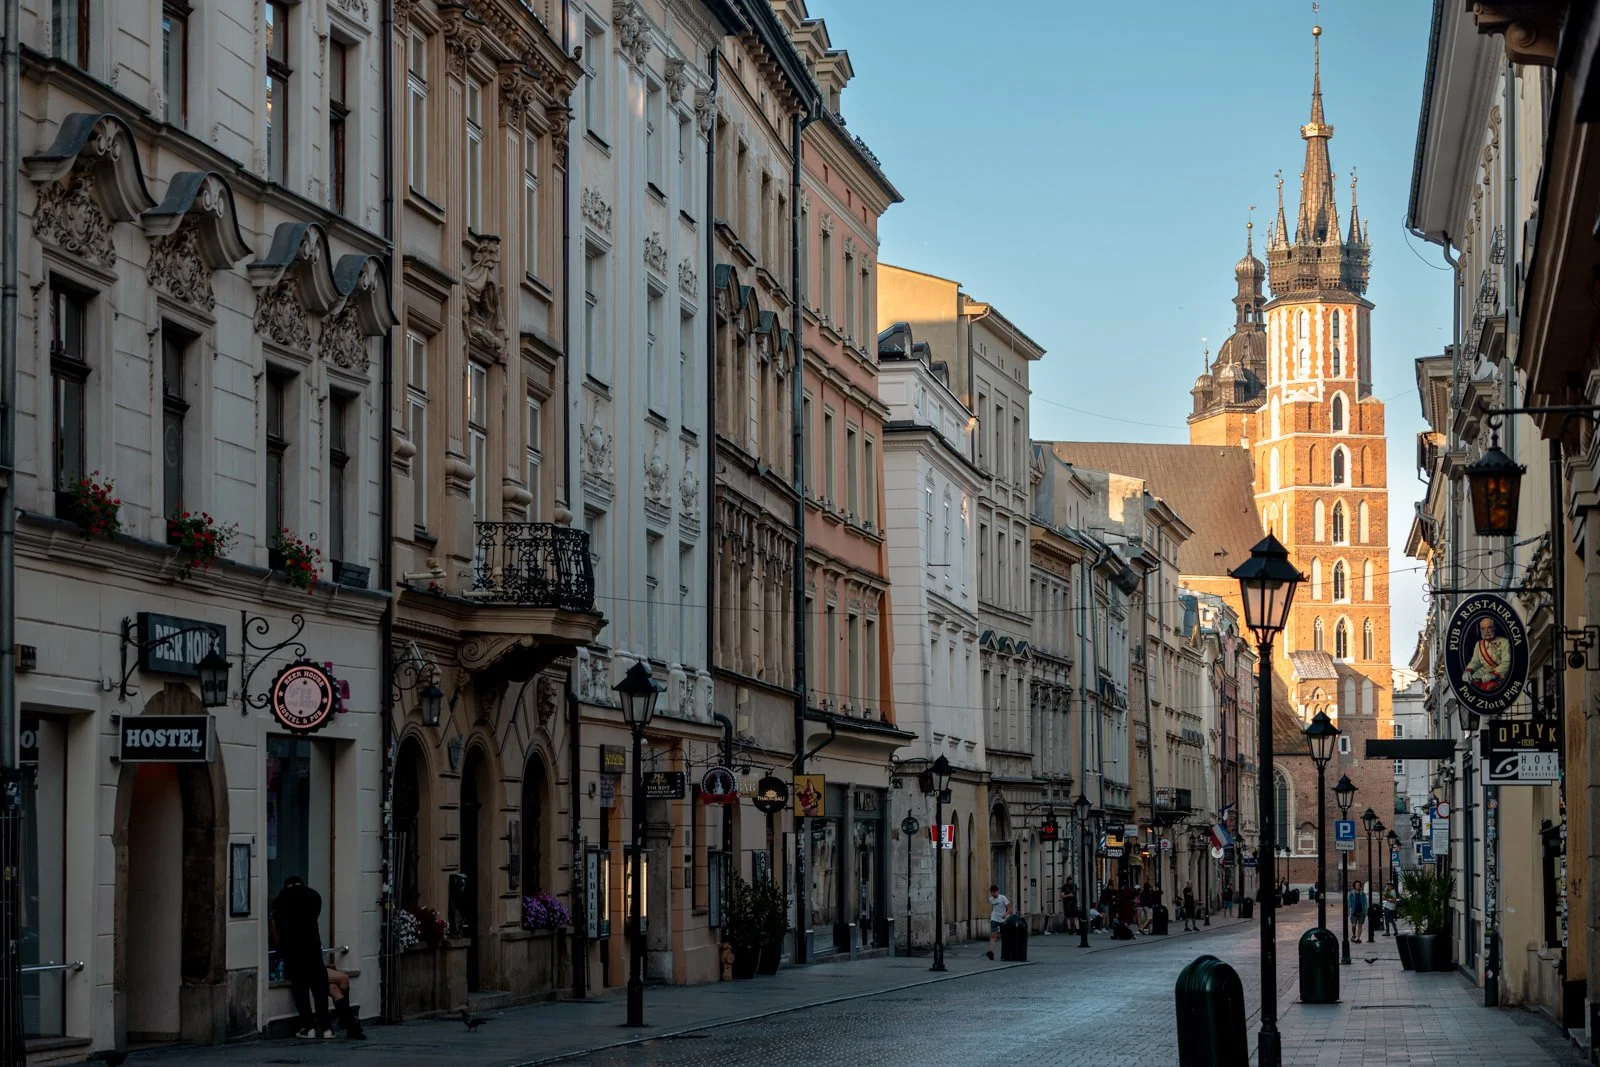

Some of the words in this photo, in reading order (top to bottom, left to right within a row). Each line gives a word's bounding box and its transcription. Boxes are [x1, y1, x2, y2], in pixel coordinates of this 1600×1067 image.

[1450, 628, 1461, 651] PUB
[1460, 599, 1522, 647] RESTAURACJA
[155, 624, 184, 662] BEER
[186, 630, 220, 664] HOUE
[283, 671, 302, 686] BEER
[303, 671, 325, 687] HOUSE
[1459, 684, 1476, 703] Pod
[278, 703, 301, 725] HOSTEL
[309, 709, 323, 723] PUB
[125, 728, 203, 748] HOSTEL
[1499, 721, 1557, 743] OPTYK
[1340, 823, 1351, 838] P
[589, 861, 597, 931] JUBILER
